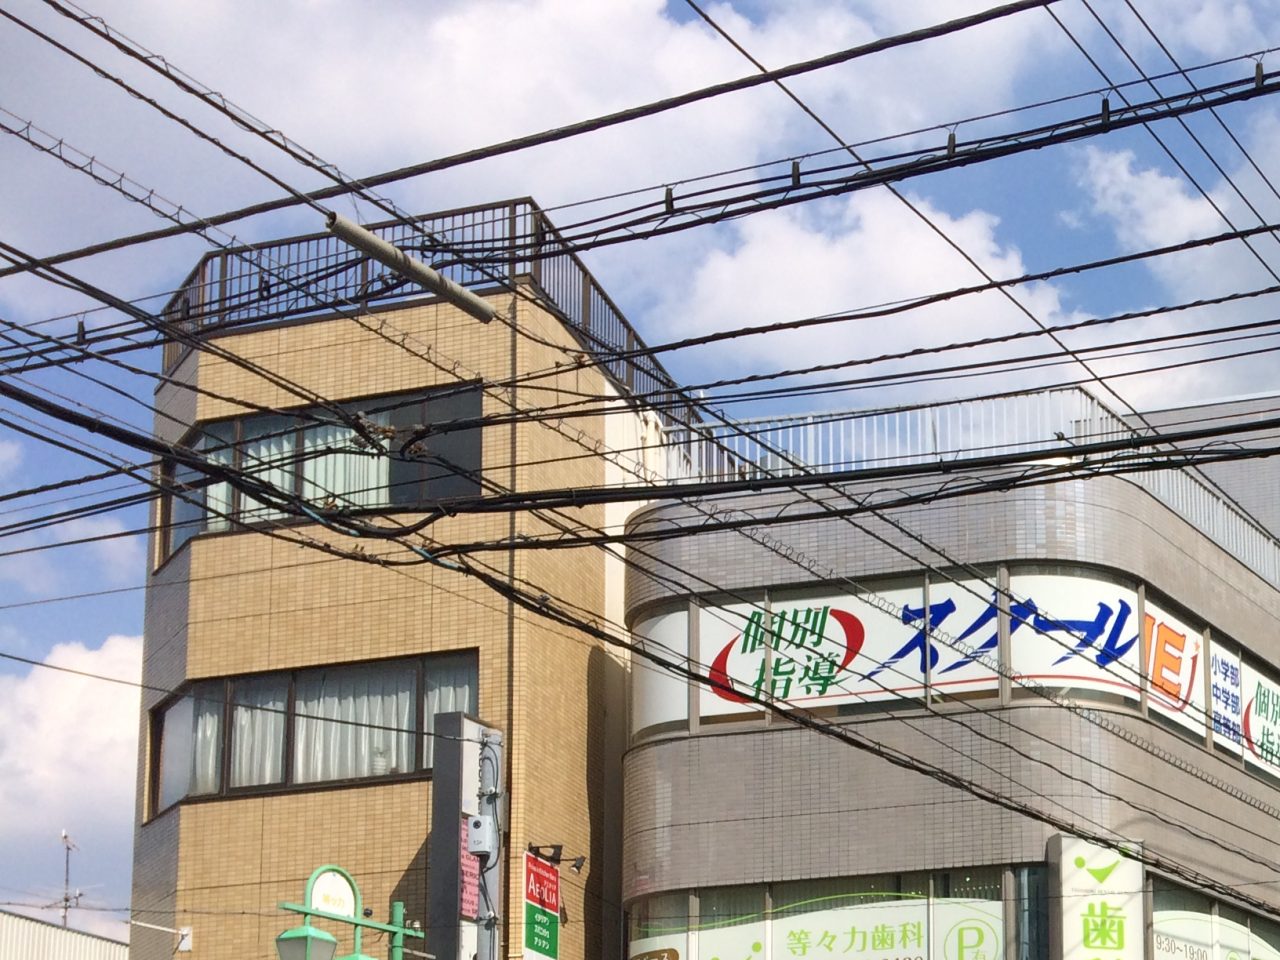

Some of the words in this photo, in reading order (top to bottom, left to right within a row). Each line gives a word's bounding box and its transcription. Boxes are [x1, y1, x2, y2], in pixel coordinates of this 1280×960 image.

[860, 592, 1140, 681] スクール
[1211, 653, 1239, 688] 小学部
[1212, 682, 1240, 716] 中学部
[528, 873, 557, 906] AEOLIA
[787, 920, 924, 956] 等々力歯科
